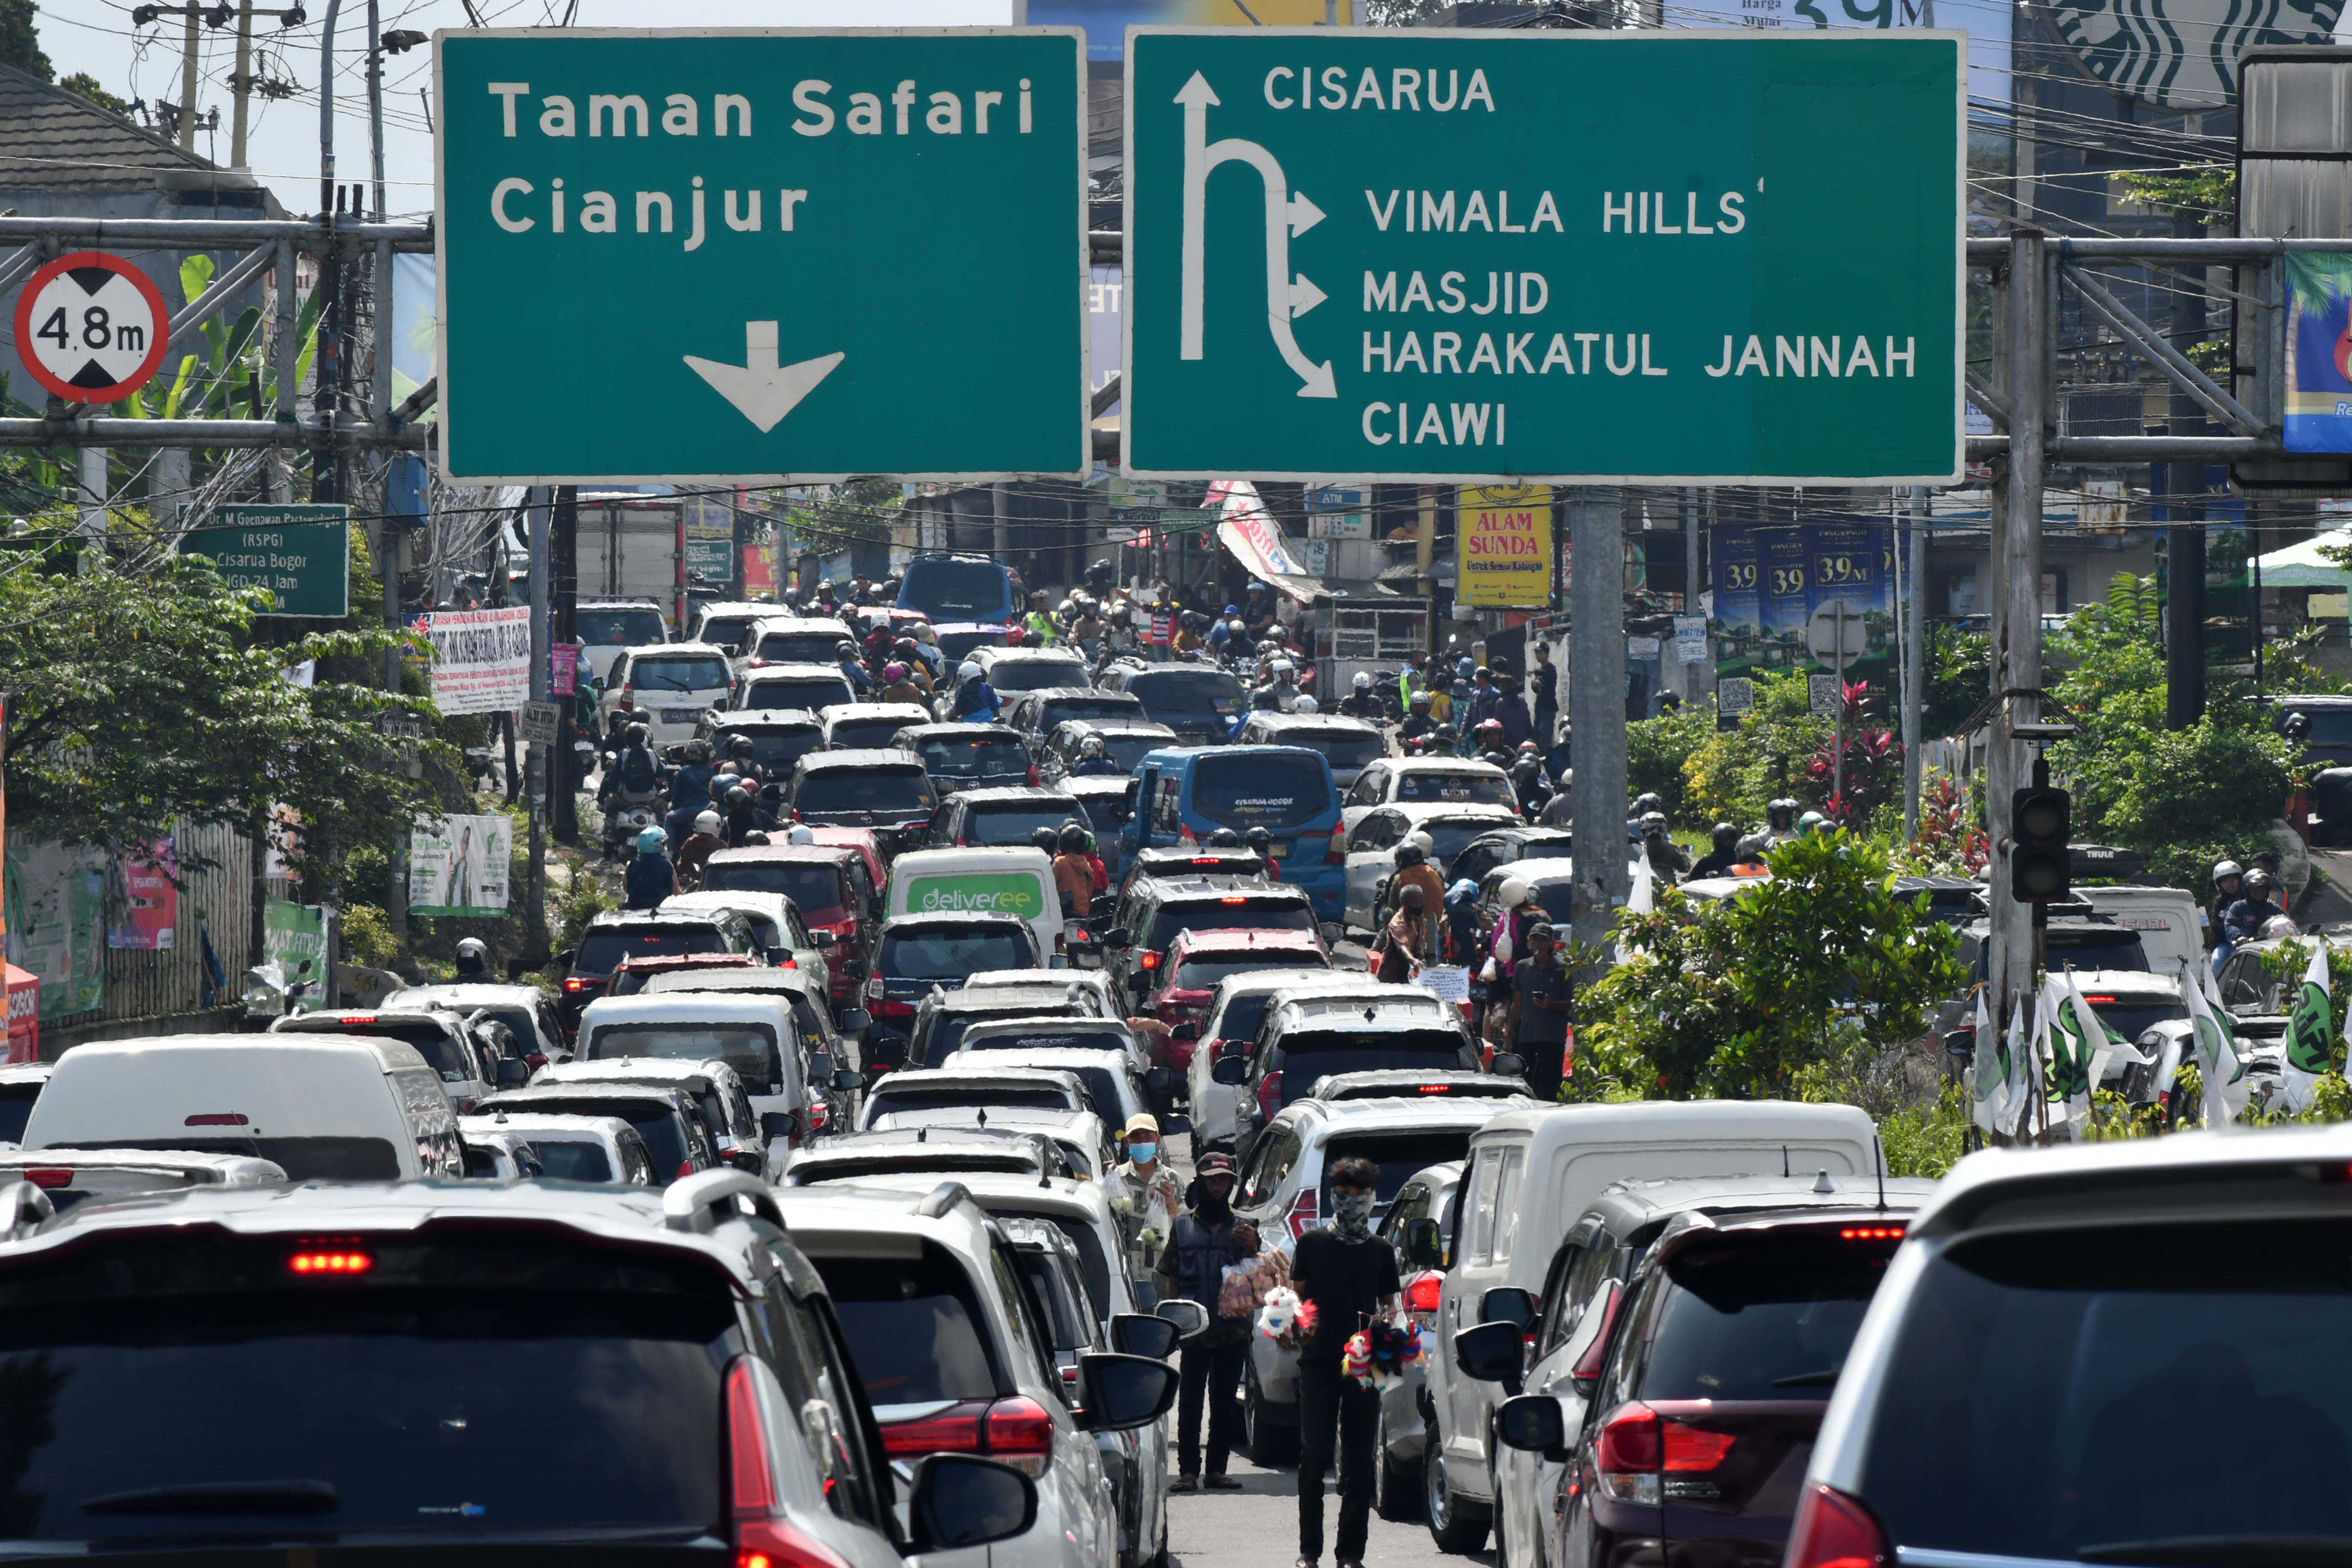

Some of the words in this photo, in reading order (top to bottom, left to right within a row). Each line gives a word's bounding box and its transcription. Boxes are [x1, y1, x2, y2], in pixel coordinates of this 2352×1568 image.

[1743, 16, 1781, 26] Mulai
[1264, 67, 1495, 112] CISARUA
[488, 82, 751, 137] Taman
[791, 78, 1032, 136] Safari
[491, 176, 808, 252] Cianjur
[1366, 190, 1564, 232] VIMALA
[1604, 191, 1746, 234] HILLS
[1364, 271, 1548, 315] MASJID
[1363, 331, 1668, 376] HARAKATUL
[1704, 334, 1915, 377] JANNAH
[1362, 402, 1504, 446] CIAWI
[1322, 493, 1343, 503] ATM
[1476, 512, 1533, 532] ALAM
[243, 533, 284, 548] (RSPG)
[1468, 535, 1539, 555] SUNDA
[217, 552, 266, 567] Cisarua
[270, 553, 308, 571] Bogor
[1467, 560, 1488, 571] Untuk
[1490, 561, 1511, 571] Semua
[1512, 561, 1543, 573] Kalangan
[227, 574, 248, 589] IGD
[253, 574, 270, 589] 24
[273, 574, 298, 589] Jam
[1852, 567, 1869, 581] M
[922, 888, 1031, 909] deliveree
